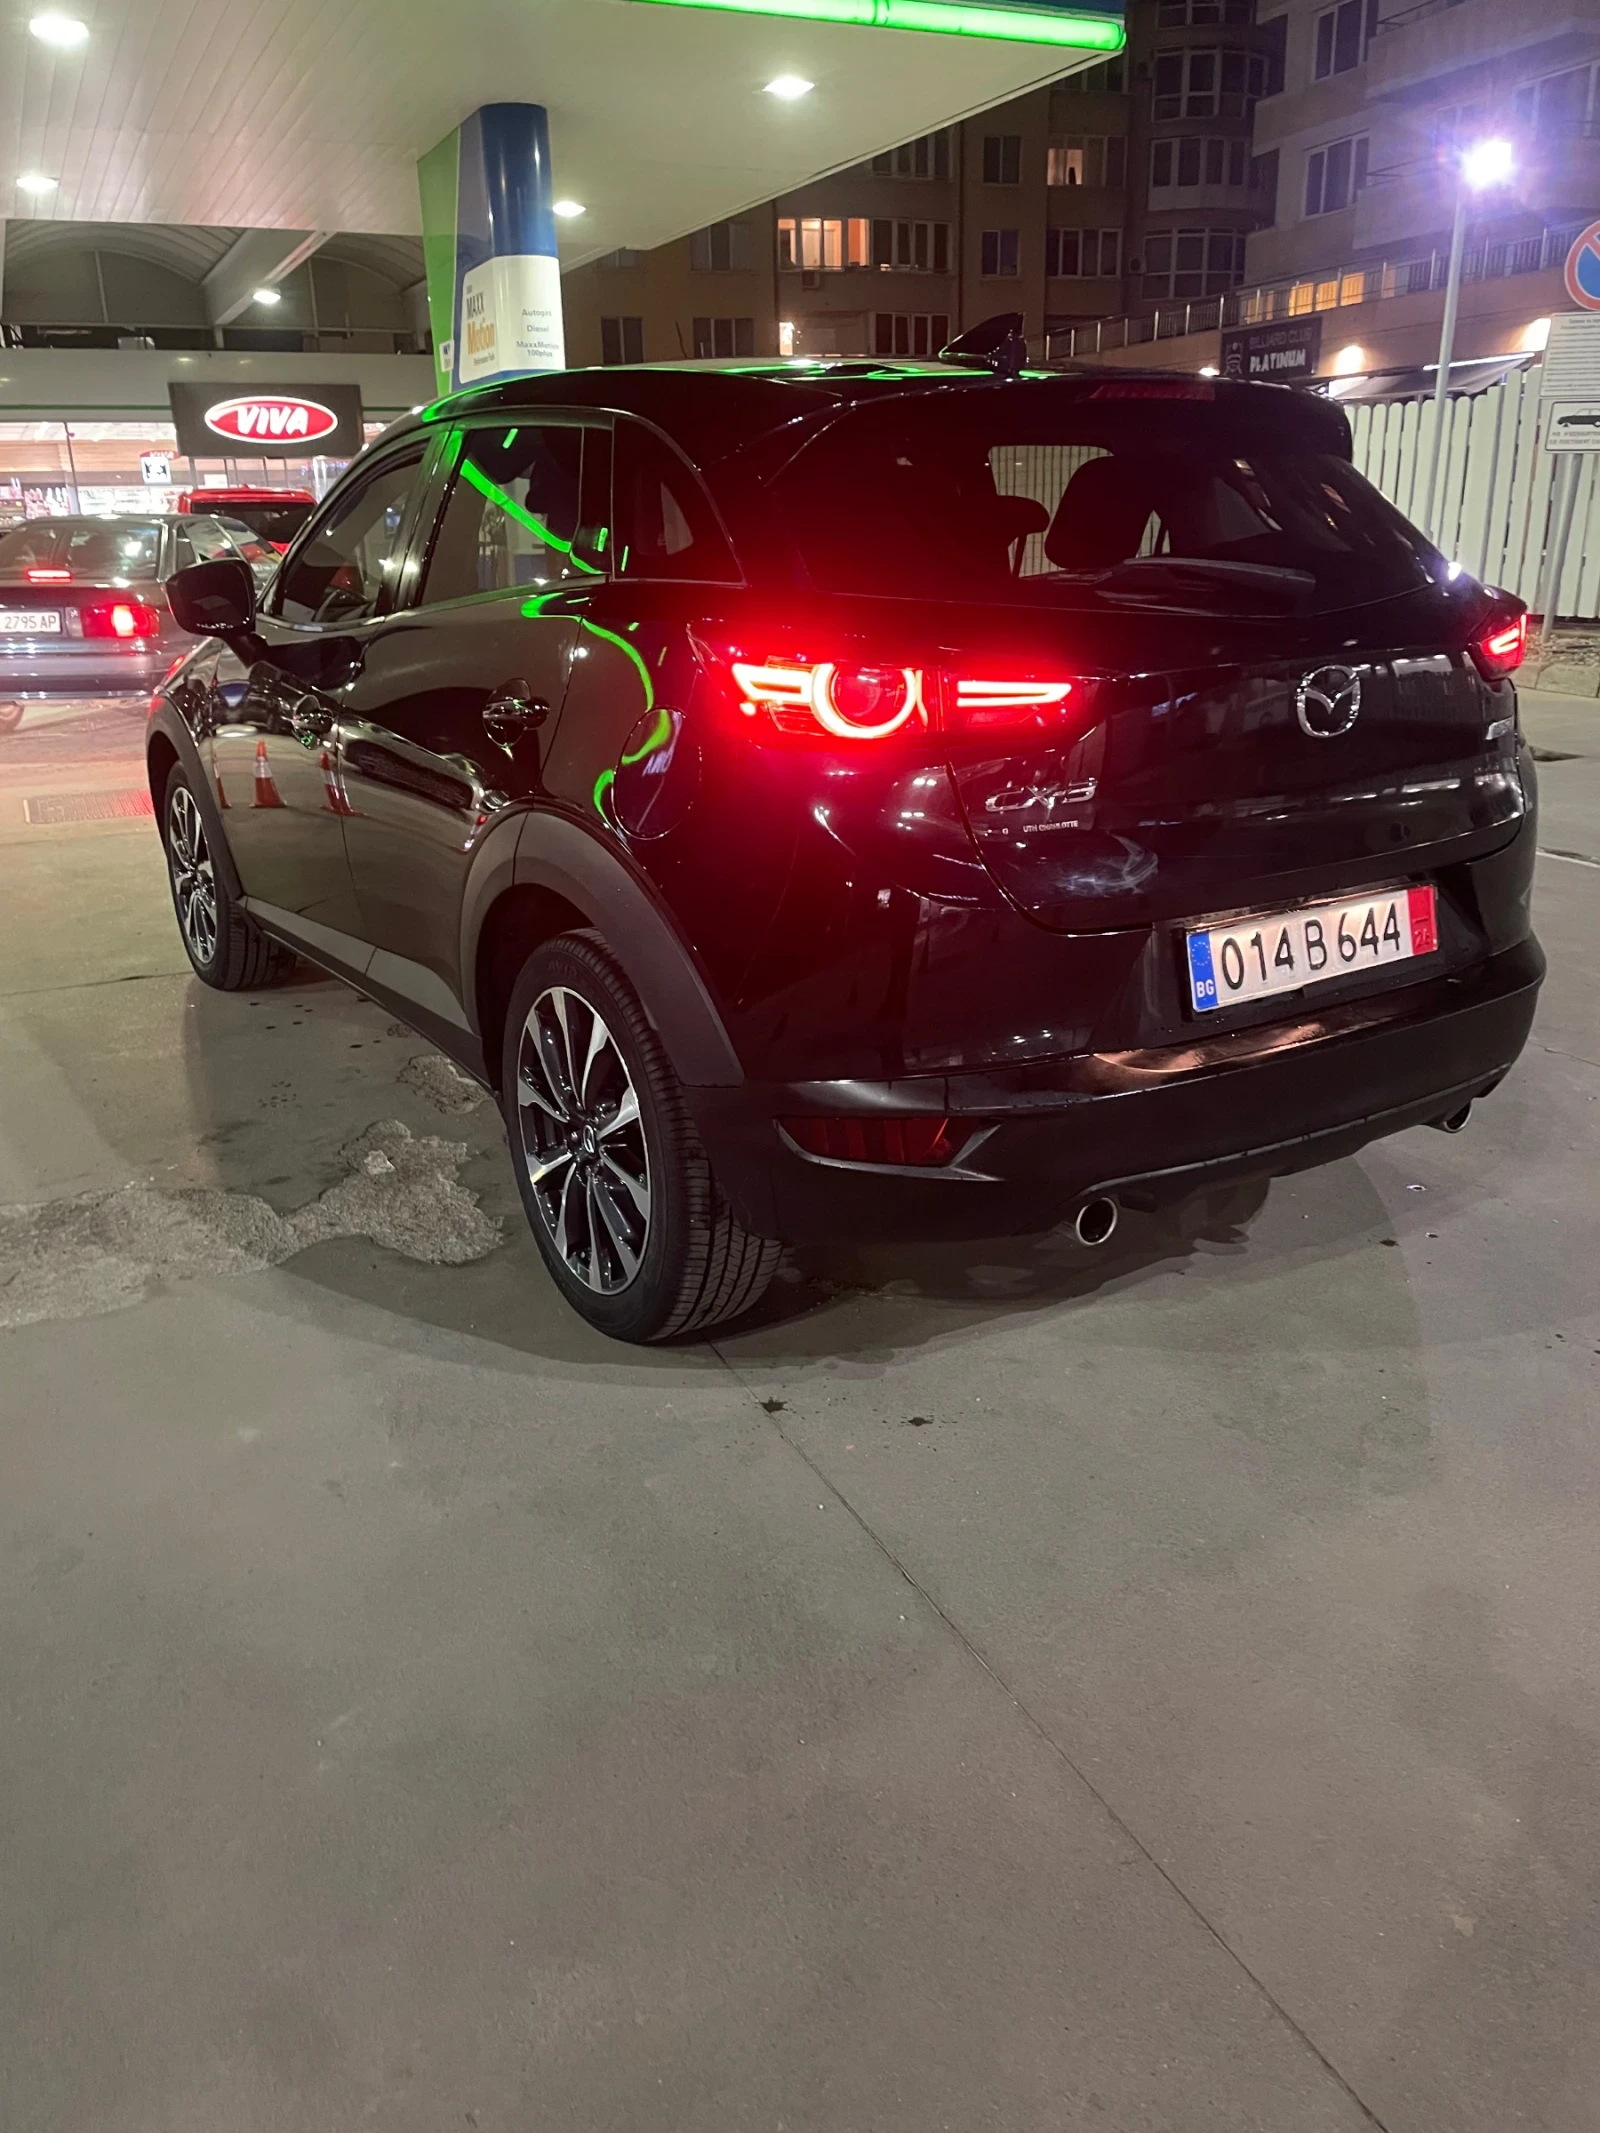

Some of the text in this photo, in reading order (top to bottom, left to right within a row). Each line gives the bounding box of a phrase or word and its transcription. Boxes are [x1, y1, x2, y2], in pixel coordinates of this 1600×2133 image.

[466, 291, 484, 320] MAXX
[522, 309, 552, 317] Autogas
[467, 321, 495, 355] Motion
[1250, 348, 1306, 372] PLATINUM
[237, 405, 308, 435] VIVA
[4, 615, 57, 629] 2795 AP
[1196, 981, 1215, 998] BG
